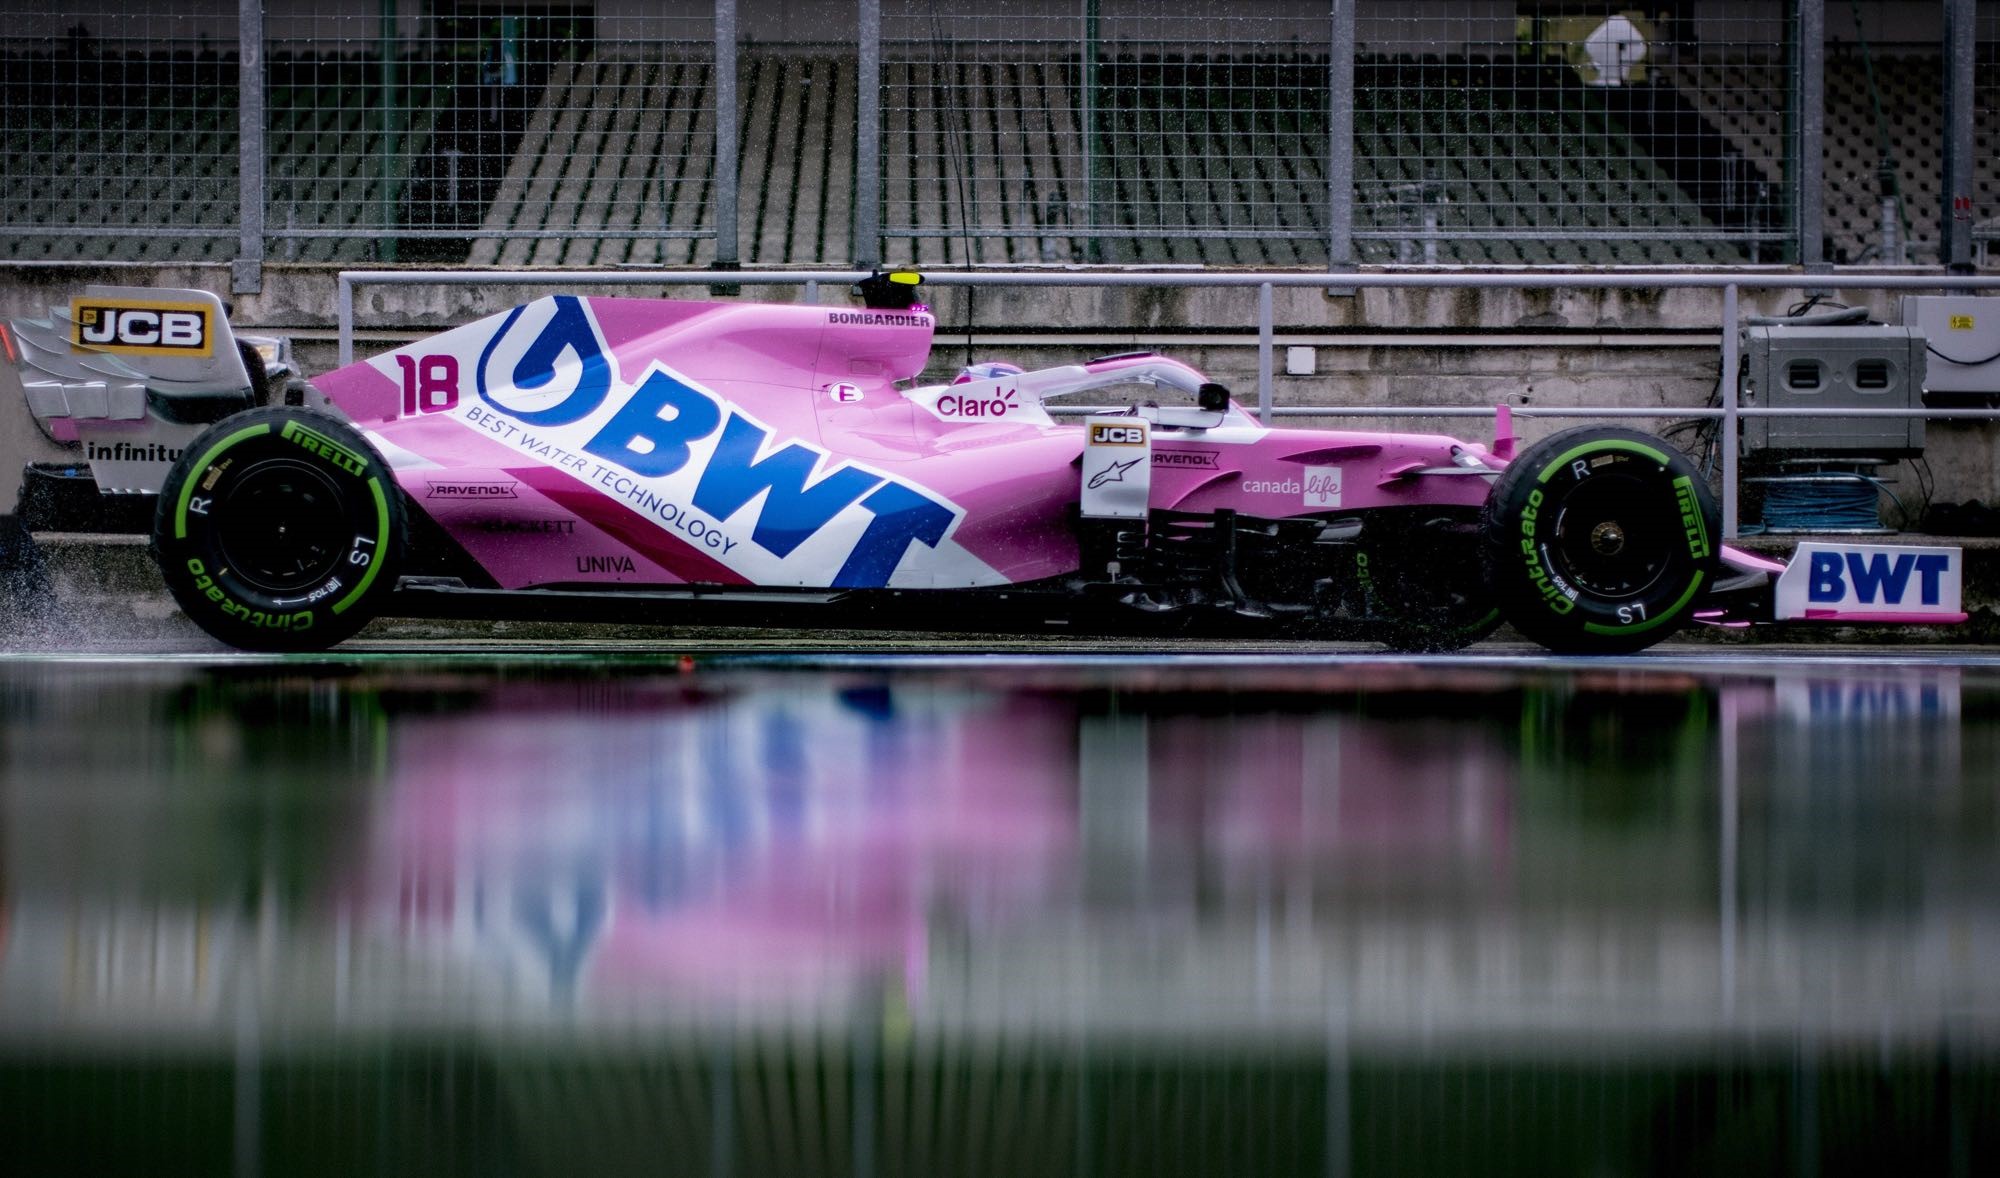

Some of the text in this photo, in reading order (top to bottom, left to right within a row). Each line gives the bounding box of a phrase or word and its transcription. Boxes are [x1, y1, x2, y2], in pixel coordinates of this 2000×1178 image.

[82, 309, 203, 346] JCB
[828, 312, 931, 328] BOMBARDIER
[395, 354, 460, 416] 18
[839, 385, 857, 402] E
[936, 395, 1006, 417] Claro
[1094, 427, 1143, 443] JCB
[88, 441, 184, 463] infinitu
[281, 419, 368, 477] PIRELLI
[1151, 453, 1211, 465] AVENOL
[466, 406, 738, 556] BEST WATER TECHNOLOGY
[582, 368, 956, 588] BWT
[1572, 459, 1591, 480] R
[436, 485, 509, 495] RAVENOL
[1242, 475, 1341, 503] canada life
[189, 496, 213, 515] R
[1671, 475, 1710, 560] PIRELLI
[1520, 488, 1575, 615] Cinturato
[577, 556, 636, 573] UNIVA
[1808, 550, 1950, 606] BWT
[188, 557, 314, 632] Cinturato
